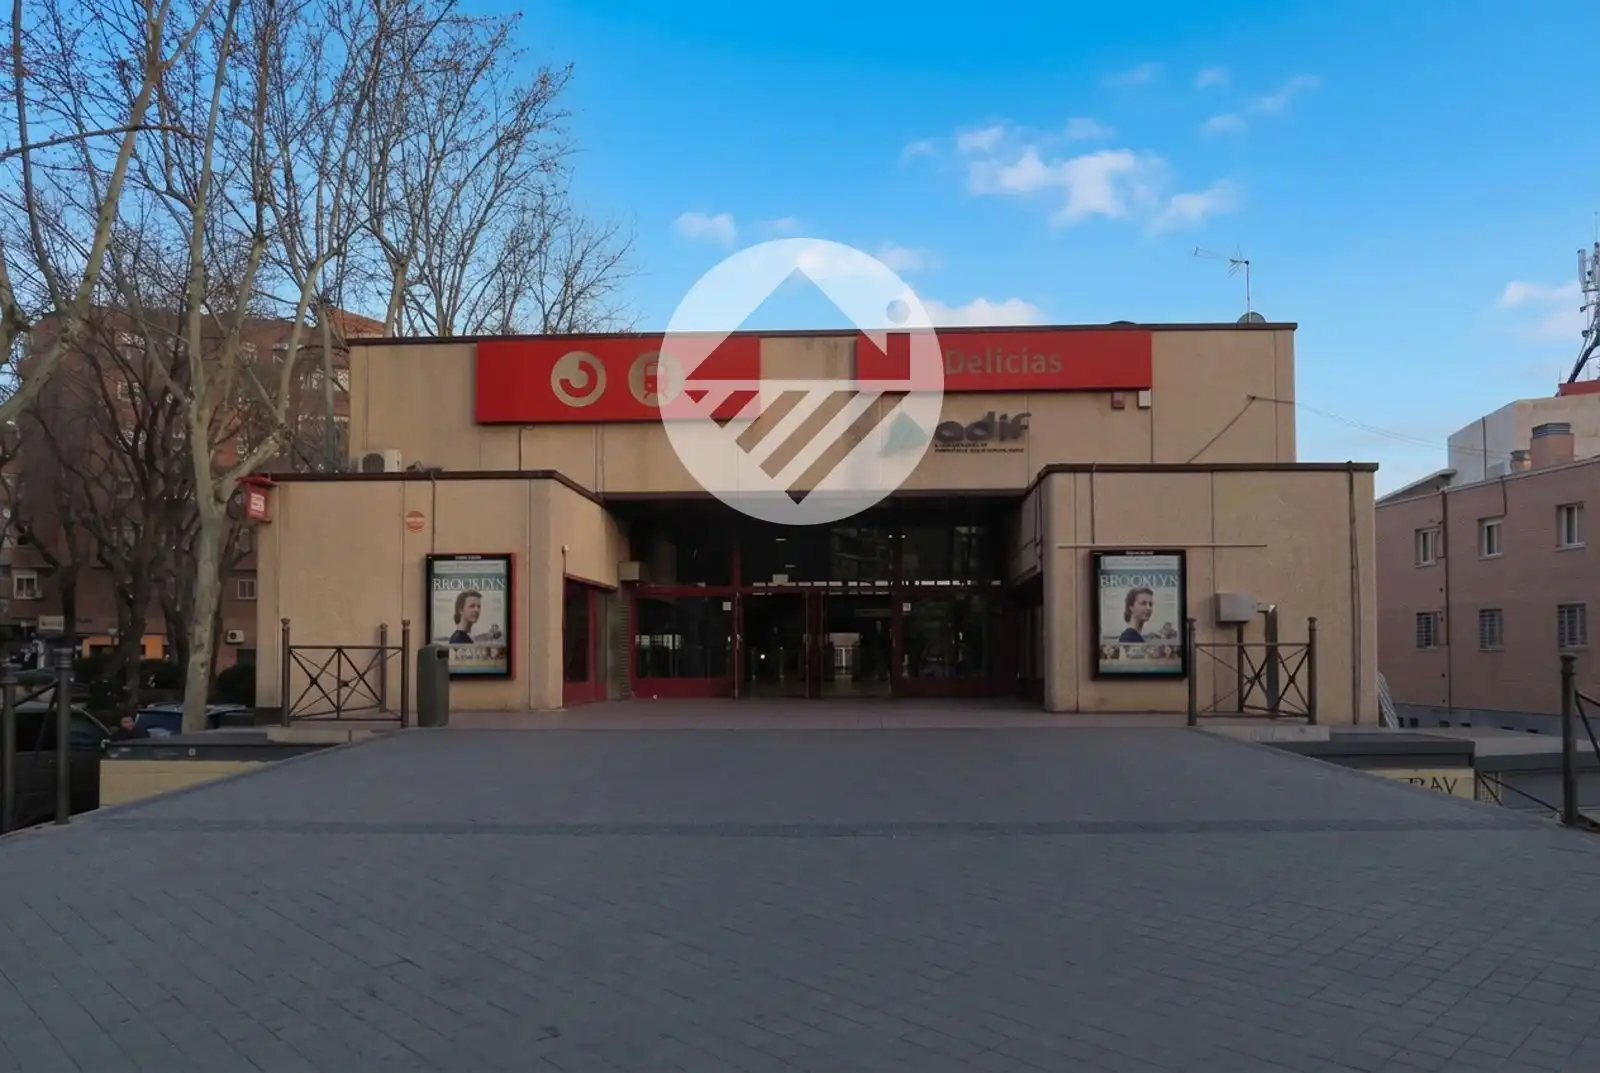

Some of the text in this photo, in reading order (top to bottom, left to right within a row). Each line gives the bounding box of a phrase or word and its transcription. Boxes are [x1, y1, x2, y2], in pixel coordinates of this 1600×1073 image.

[945, 348, 1063, 375] Delicias
[933, 411, 1032, 442] adif
[1100, 574, 1178, 589] BROOKLYN
